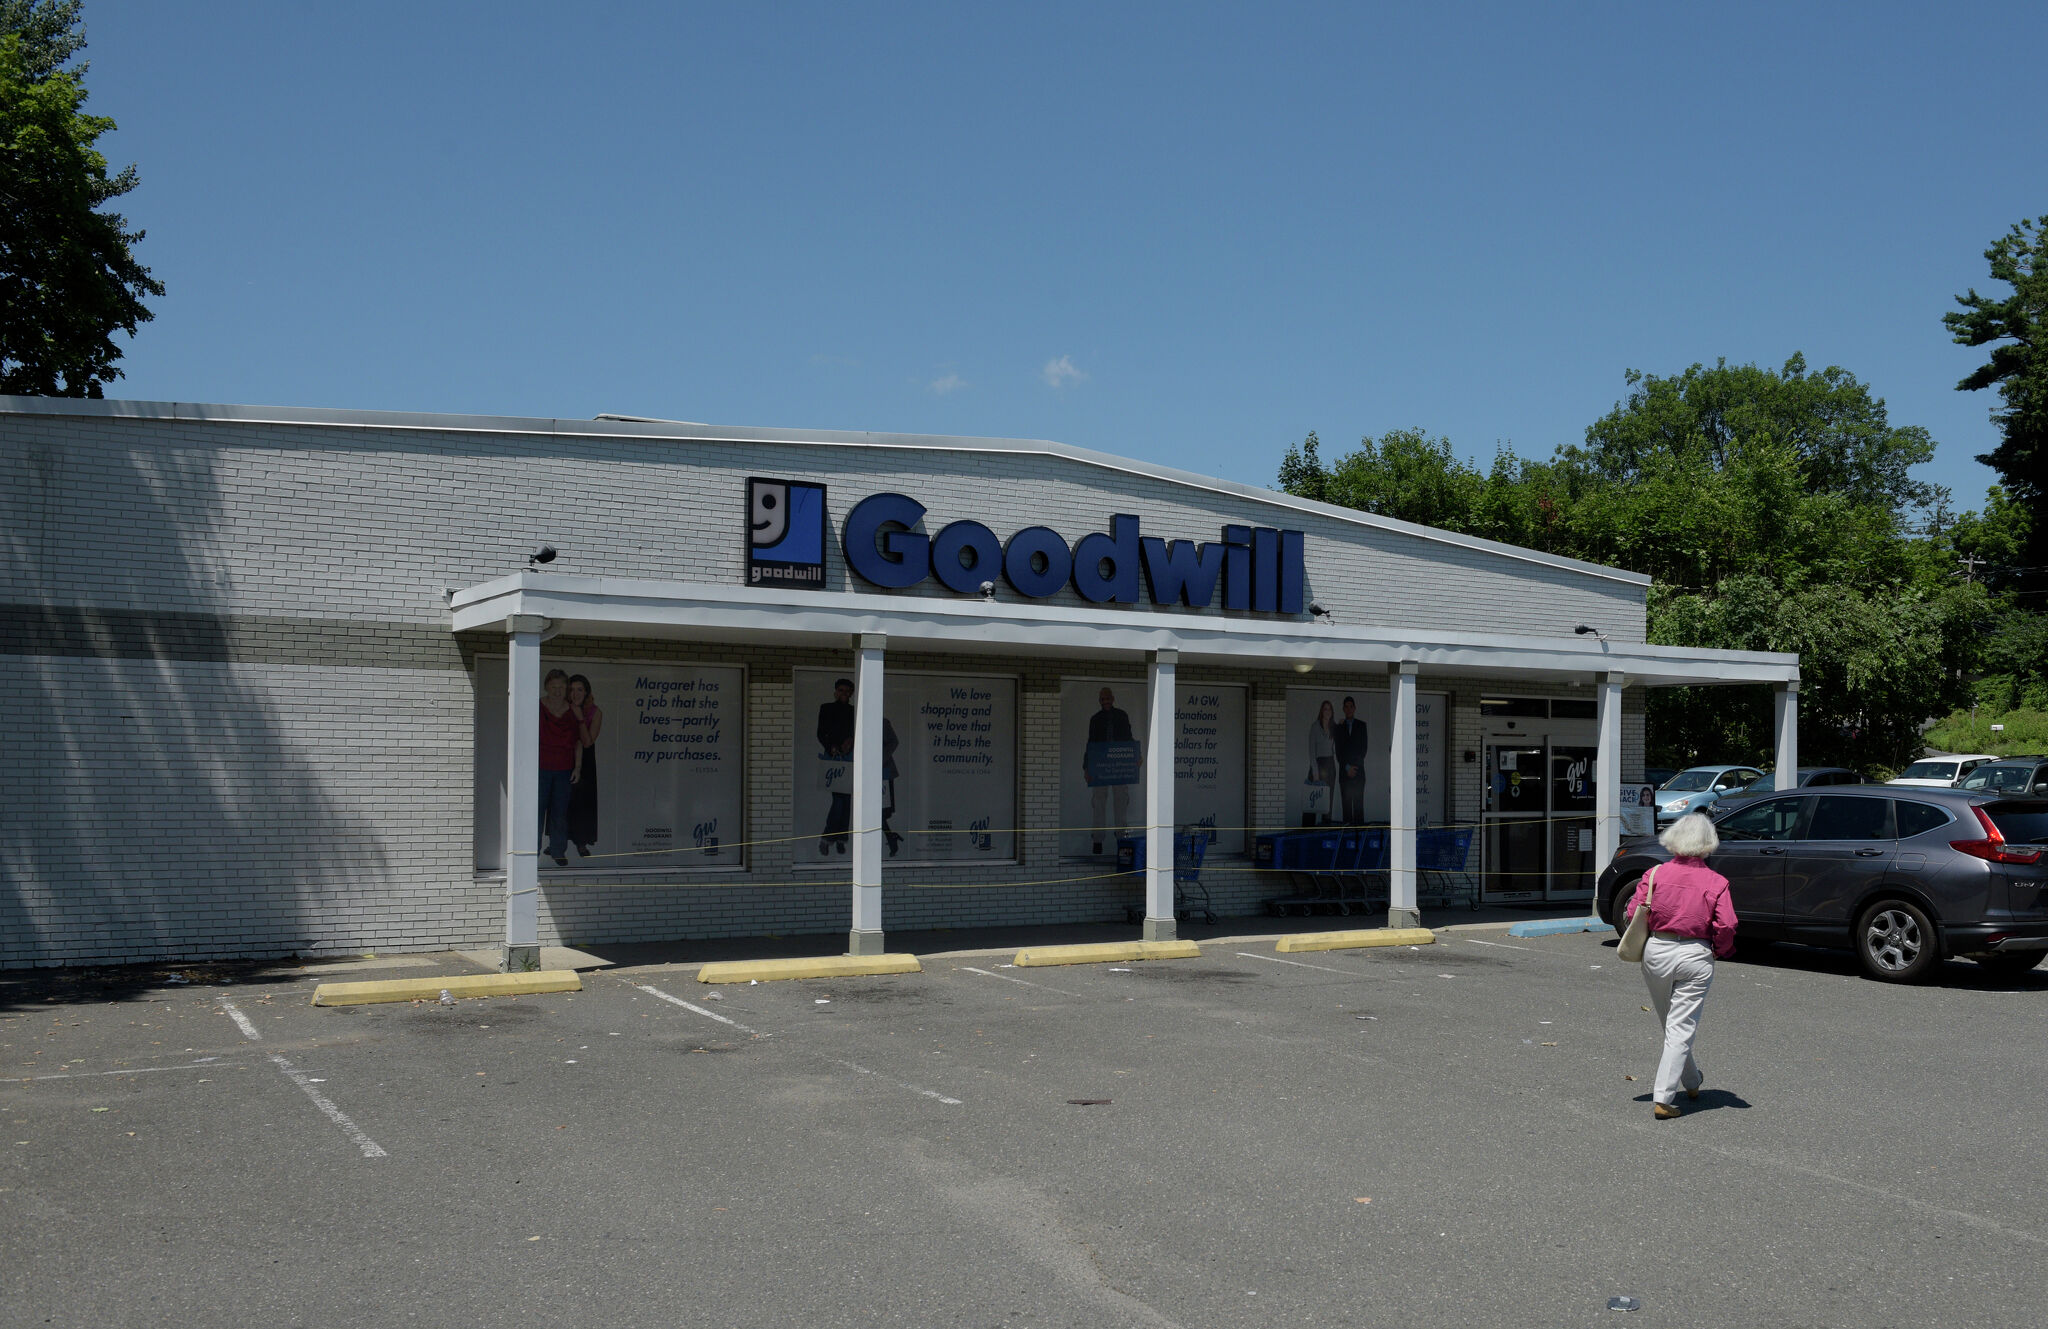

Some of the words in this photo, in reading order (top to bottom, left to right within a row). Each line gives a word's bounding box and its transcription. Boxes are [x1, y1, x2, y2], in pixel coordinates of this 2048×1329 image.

[842, 492, 1304, 614] Goodwill
[751, 565, 822, 583] goodwill
[635, 677, 695, 694] Margaret
[698, 678, 719, 692] has
[950, 687, 968, 701] We
[970, 688, 991, 701] love
[1188, 695, 1198, 705] At
[1200, 695, 1219, 708] GW,
[635, 698, 644, 707] a
[647, 695, 667, 711] job
[671, 695, 696, 709] that
[699, 696, 719, 710] she
[921, 702, 969, 719] shopping
[971, 704, 991, 716] and
[1174, 708, 1217, 720] donations
[928, 721, 943, 731] we
[946, 719, 968, 732] love
[970, 720, 991, 732] that
[1182, 723, 1217, 735] become
[652, 729, 703, 743] because
[706, 730, 720, 743] of
[933, 735, 942, 746] it
[944, 735, 971, 750] helps
[974, 735, 991, 748] the
[1204, 738, 1218, 750] for
[634, 750, 654, 764] my
[656, 747, 721, 764] purchases.
[933, 752, 993, 767] community.
[1197, 767, 1217, 782] you!
